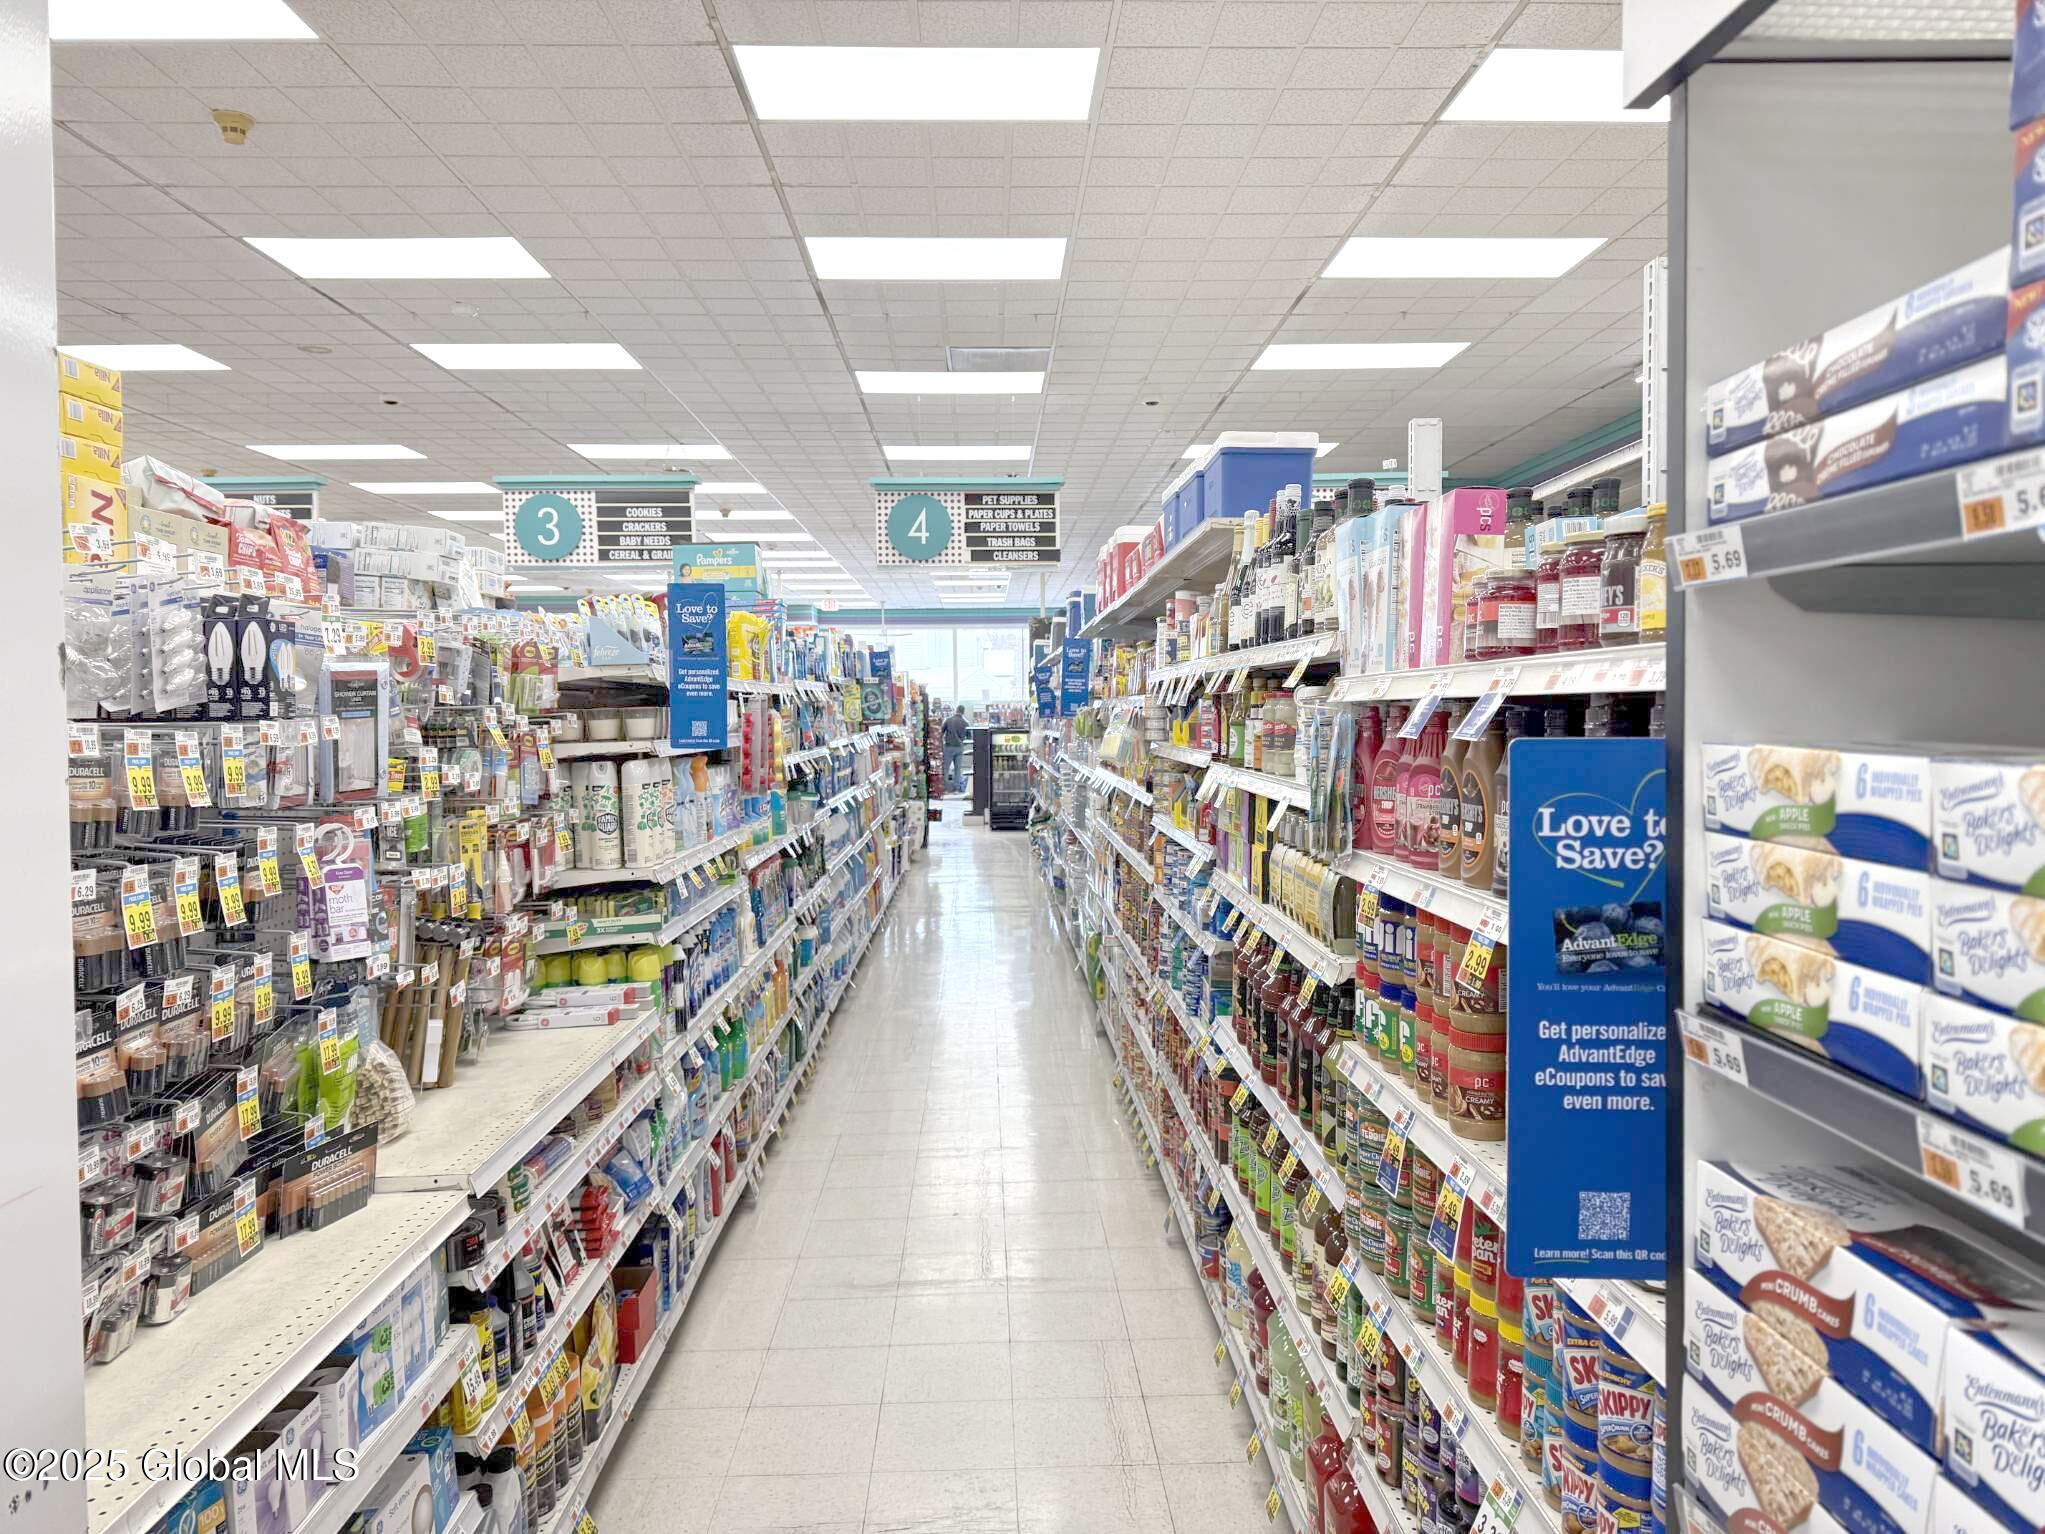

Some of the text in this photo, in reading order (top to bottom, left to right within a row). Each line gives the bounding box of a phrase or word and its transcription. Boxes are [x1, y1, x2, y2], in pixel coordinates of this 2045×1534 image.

[253, 495, 275, 504] NUTS
[982, 496, 1038, 505] PET SUPPLIES
[626, 508, 662, 517] COOKIES
[968, 509, 1053, 519] PAPER CUPS & PLATES
[1476, 506, 1492, 532] pcs
[537, 507, 560, 545] 3
[622, 522, 667, 532] CRACKERS
[908, 507, 929, 544] 4
[980, 522, 1040, 532] PAPER TOWELS
[619, 536, 671, 546] BABY NEEDS
[987, 537, 1035, 547] TRASH BAGS
[609, 551, 640, 560] CEREAL
[642, 551, 649, 560] &
[697, 554, 733, 566] Pampers
[993, 551, 1039, 561] CLEANSERS
[1711, 551, 1741, 571] 5.69
[676, 603, 718, 614] Love to
[681, 613, 714, 624] Save?
[420, 641, 434, 656] 2.99
[68, 767, 104, 777] DURACELL
[227, 766, 243, 783] 9.99
[1856, 763, 1868, 799] 6
[132, 776, 152, 794] 9.99
[186, 775, 204, 792] 9.99
[1538, 808, 1631, 838] Love
[1780, 808, 1809, 822] APPLE
[1974, 819, 2037, 858] Delights
[1556, 839, 1665, 870] Save?
[263, 866, 277, 882] 9.99
[77, 885, 94, 898] 6.29
[1858, 871, 1869, 908] 6
[224, 893, 241, 912] 9.99
[328, 895, 352, 905] moth
[330, 904, 345, 914] bar
[181, 901, 198, 921] 9.99
[1781, 906, 1811, 922] APPLE
[129, 911, 151, 932] 9.99
[1561, 932, 1658, 952] AdvantEdge
[1464, 949, 1487, 976] 2.99
[1968, 946, 2030, 981] Delights
[296, 971, 309, 986] 9.99
[1562, 983, 1579, 992] love
[1580, 985, 1601, 993] your
[179, 990, 190, 1001] 6.29
[257, 993, 271, 1007] 9.99
[1849, 975, 1861, 1012] 6
[120, 1007, 158, 1031] DURACELL
[161, 997, 200, 1021] DURACELL
[215, 1006, 232, 1026] 9.99
[1773, 1003, 1803, 1021] APPLE
[1539, 1021, 1567, 1039] Get
[323, 1043, 338, 1061] 17.99
[1558, 1045, 1656, 1067] AdvantEdge
[1713, 1049, 1741, 1073] 5.69
[1535, 1068, 1615, 1089] eCoupons
[1620, 1070, 1636, 1086] to
[1965, 1068, 2028, 1103] Delights
[1465, 1095, 1496, 1105] CREAMY
[1563, 1095, 1655, 1111] even more.
[241, 1105, 258, 1126] 17.99
[1387, 1138, 1400, 1157] 2.49
[311, 1146, 353, 1171] DURACELL
[1969, 1169, 2015, 1209] 5.69
[1441, 1194, 1457, 1217] 2.49
[239, 1218, 256, 1238] 17.99
[1533, 1247, 1559, 1259] Learn
[1561, 1248, 1589, 1259] more!
[1591, 1248, 1614, 1260] Scan
[1615, 1248, 1633, 1260] this
[1635, 1248, 1649, 1261] QR
[1720, 1234, 1764, 1262] Delights
[1331, 1276, 1345, 1300] 3.99
[1775, 1279, 1817, 1314] CRUMB
[1863, 1292, 1875, 1330] 6
[1361, 1327, 1376, 1352] 3.99
[1710, 1348, 1754, 1382] Delights
[466, 1369, 481, 1394] 15.49
[1765, 1402, 1807, 1444] CRUMB
[1853, 1429, 1864, 1467] 6
[1705, 1456, 1747, 1497] Delights
